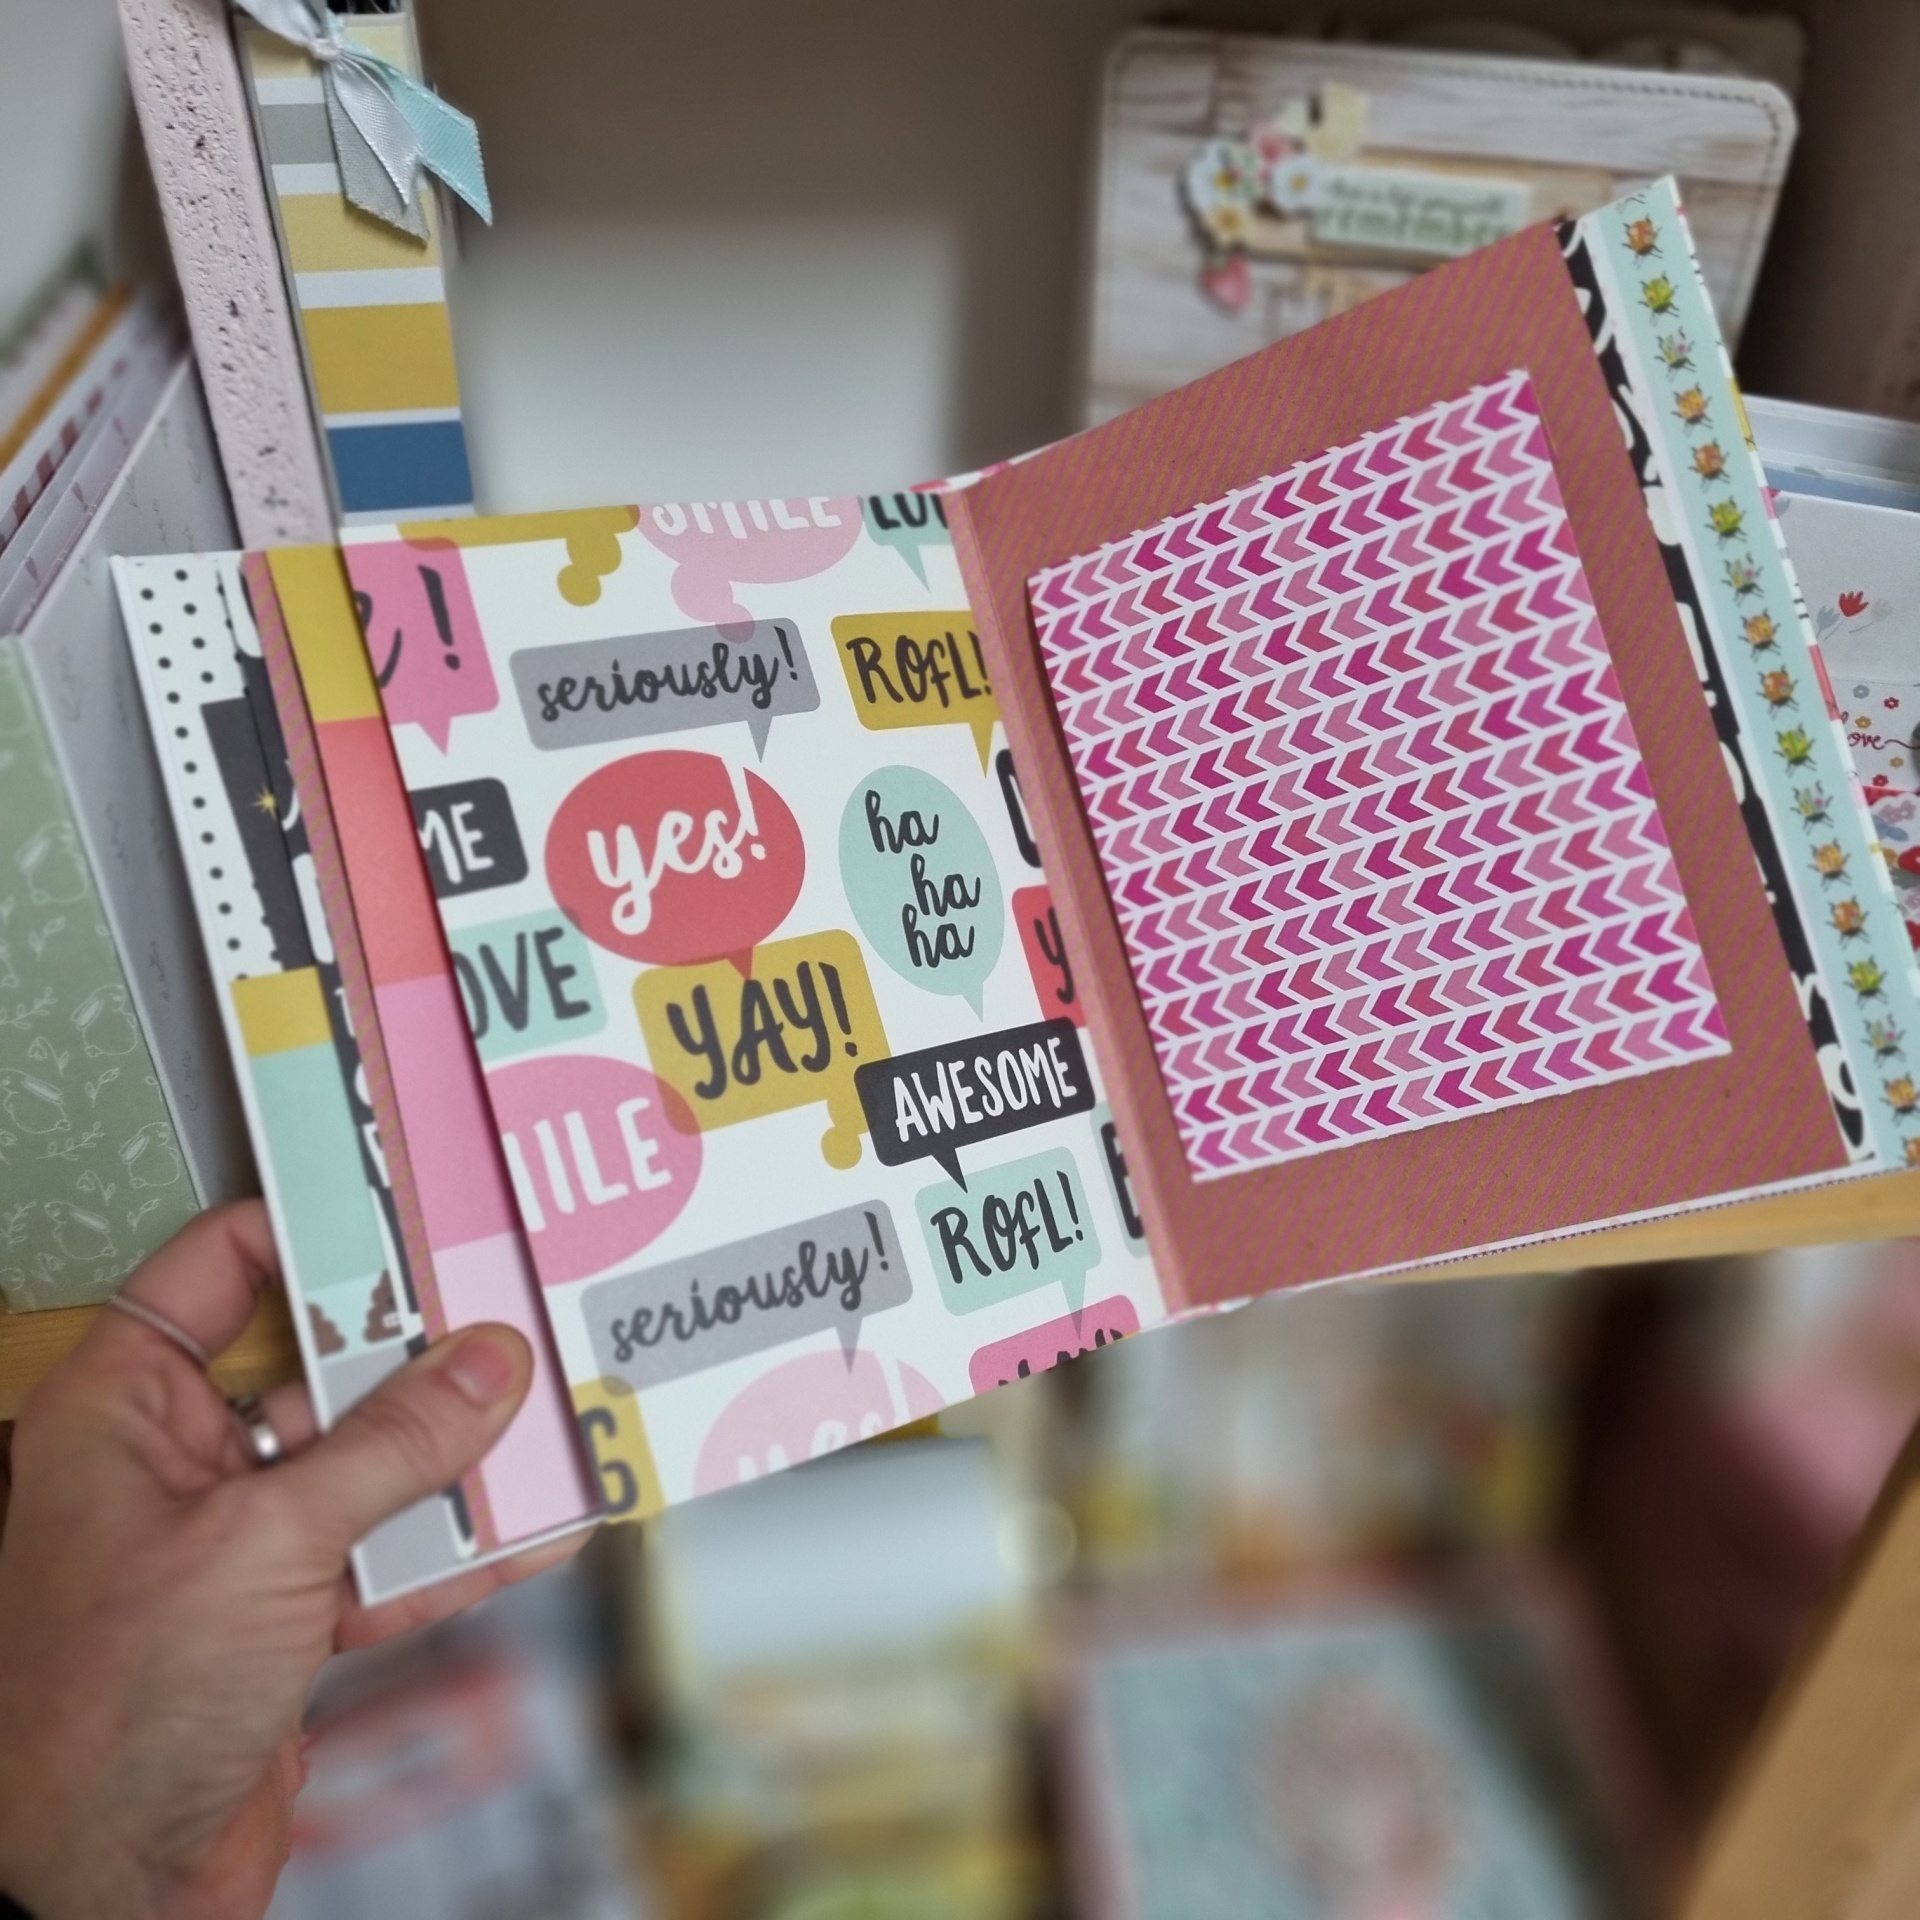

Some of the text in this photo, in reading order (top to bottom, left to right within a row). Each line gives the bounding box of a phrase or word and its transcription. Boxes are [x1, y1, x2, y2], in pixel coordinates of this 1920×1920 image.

[537, 626, 799, 722] seriously!
[846, 630, 992, 708] ROFL!
[1840, 711, 1886, 751] ove
[587, 757, 767, 936] yes!
[865, 789, 939, 854] ha
[910, 853, 981, 917] ha
[901, 903, 975, 968] ha
[666, 961, 859, 1100] YAY!
[891, 1037, 1078, 1143] AWESOME
[930, 1170, 1084, 1284] ROFL!
[610, 1210, 889, 1364] seriously!
